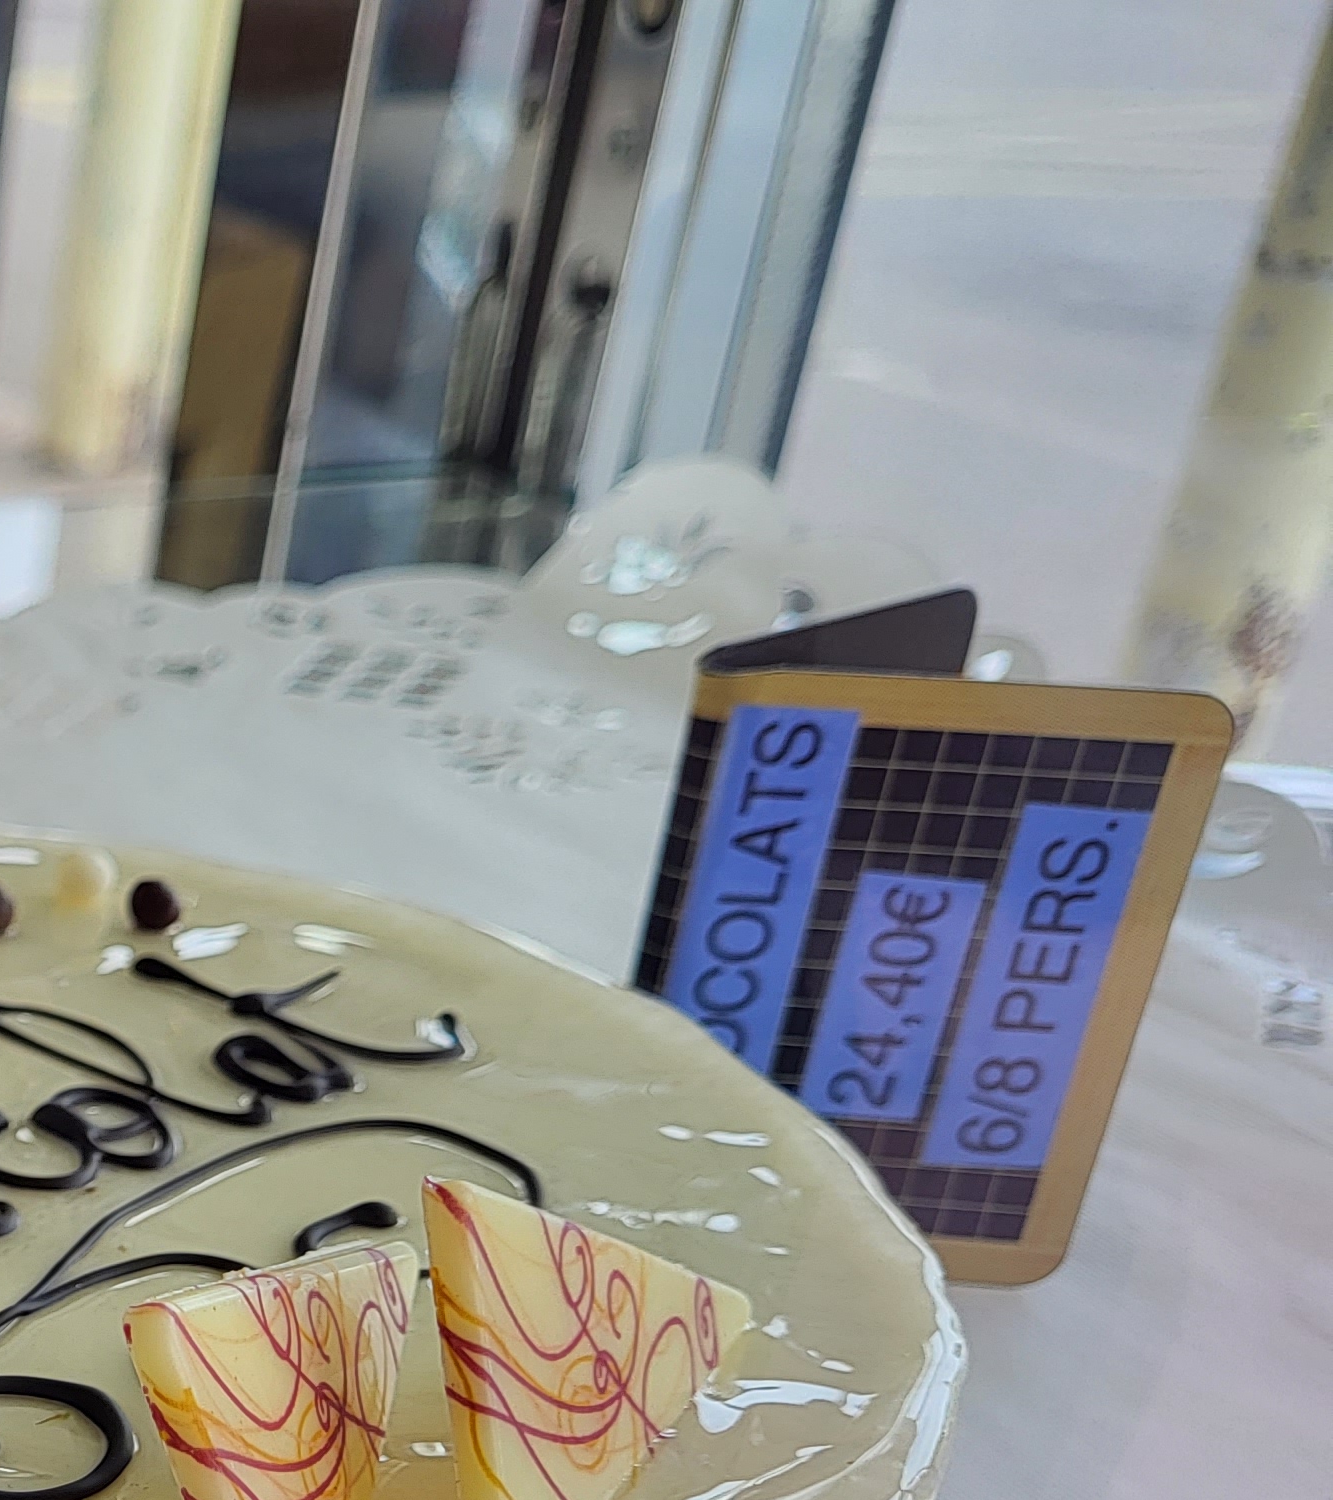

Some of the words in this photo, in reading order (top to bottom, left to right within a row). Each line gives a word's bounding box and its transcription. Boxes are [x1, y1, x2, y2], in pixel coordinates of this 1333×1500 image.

[827, 883, 951, 1108] 24,40€
[994, 818, 1121, 1033] PERS.
[957, 1057, 1044, 1154] 6/8
